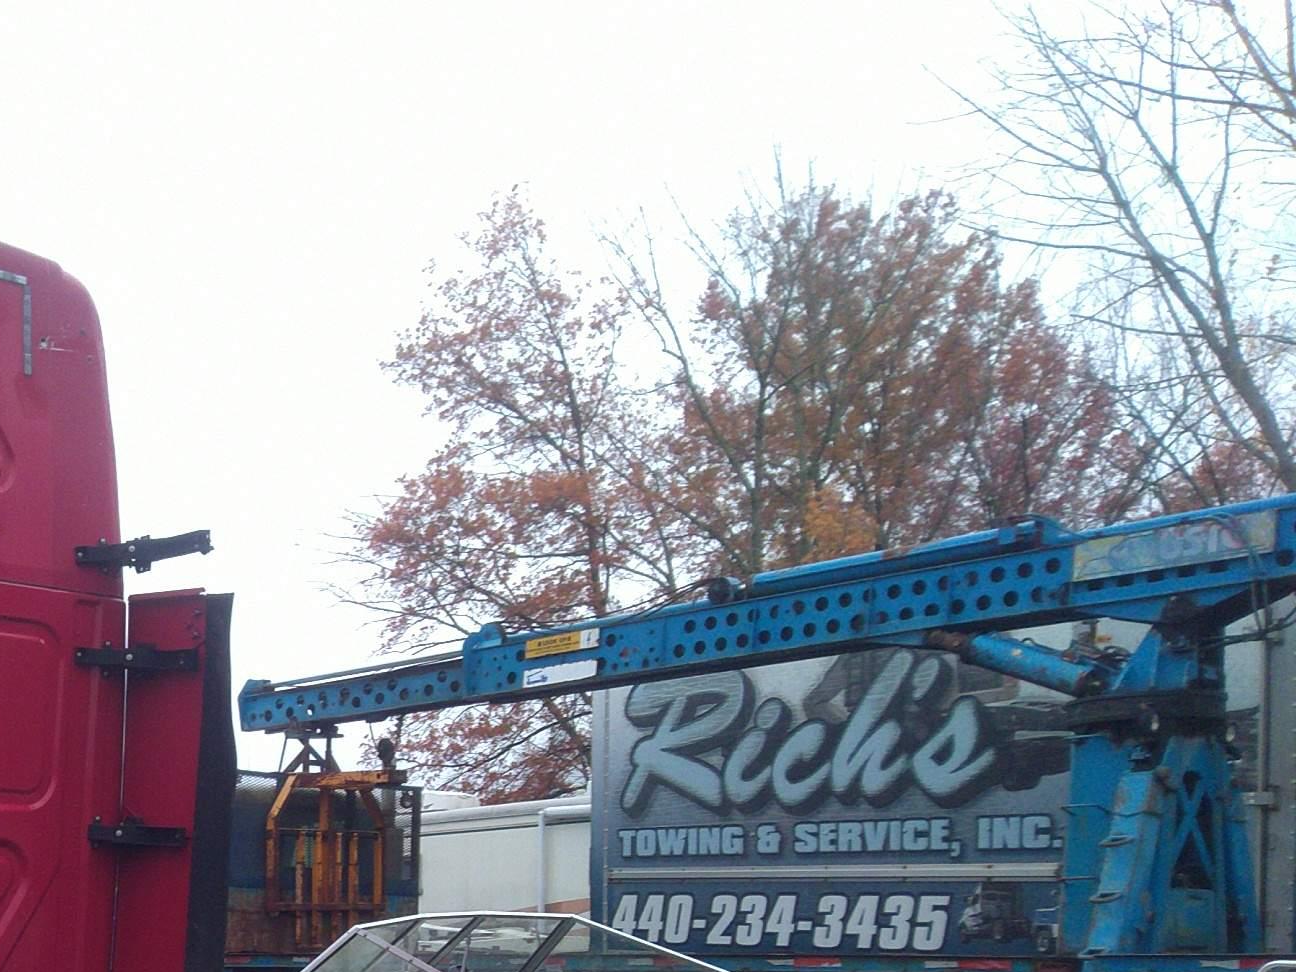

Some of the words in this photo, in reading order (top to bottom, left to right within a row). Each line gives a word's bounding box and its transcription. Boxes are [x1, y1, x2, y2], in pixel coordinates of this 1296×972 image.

[620, 646, 998, 814] Rich's
[619, 826, 744, 857] TOWING
[757, 823, 781, 854] &
[794, 818, 961, 857] SERVICE,
[977, 814, 1063, 849] INC.
[612, 894, 951, 951] 440-234-3435
